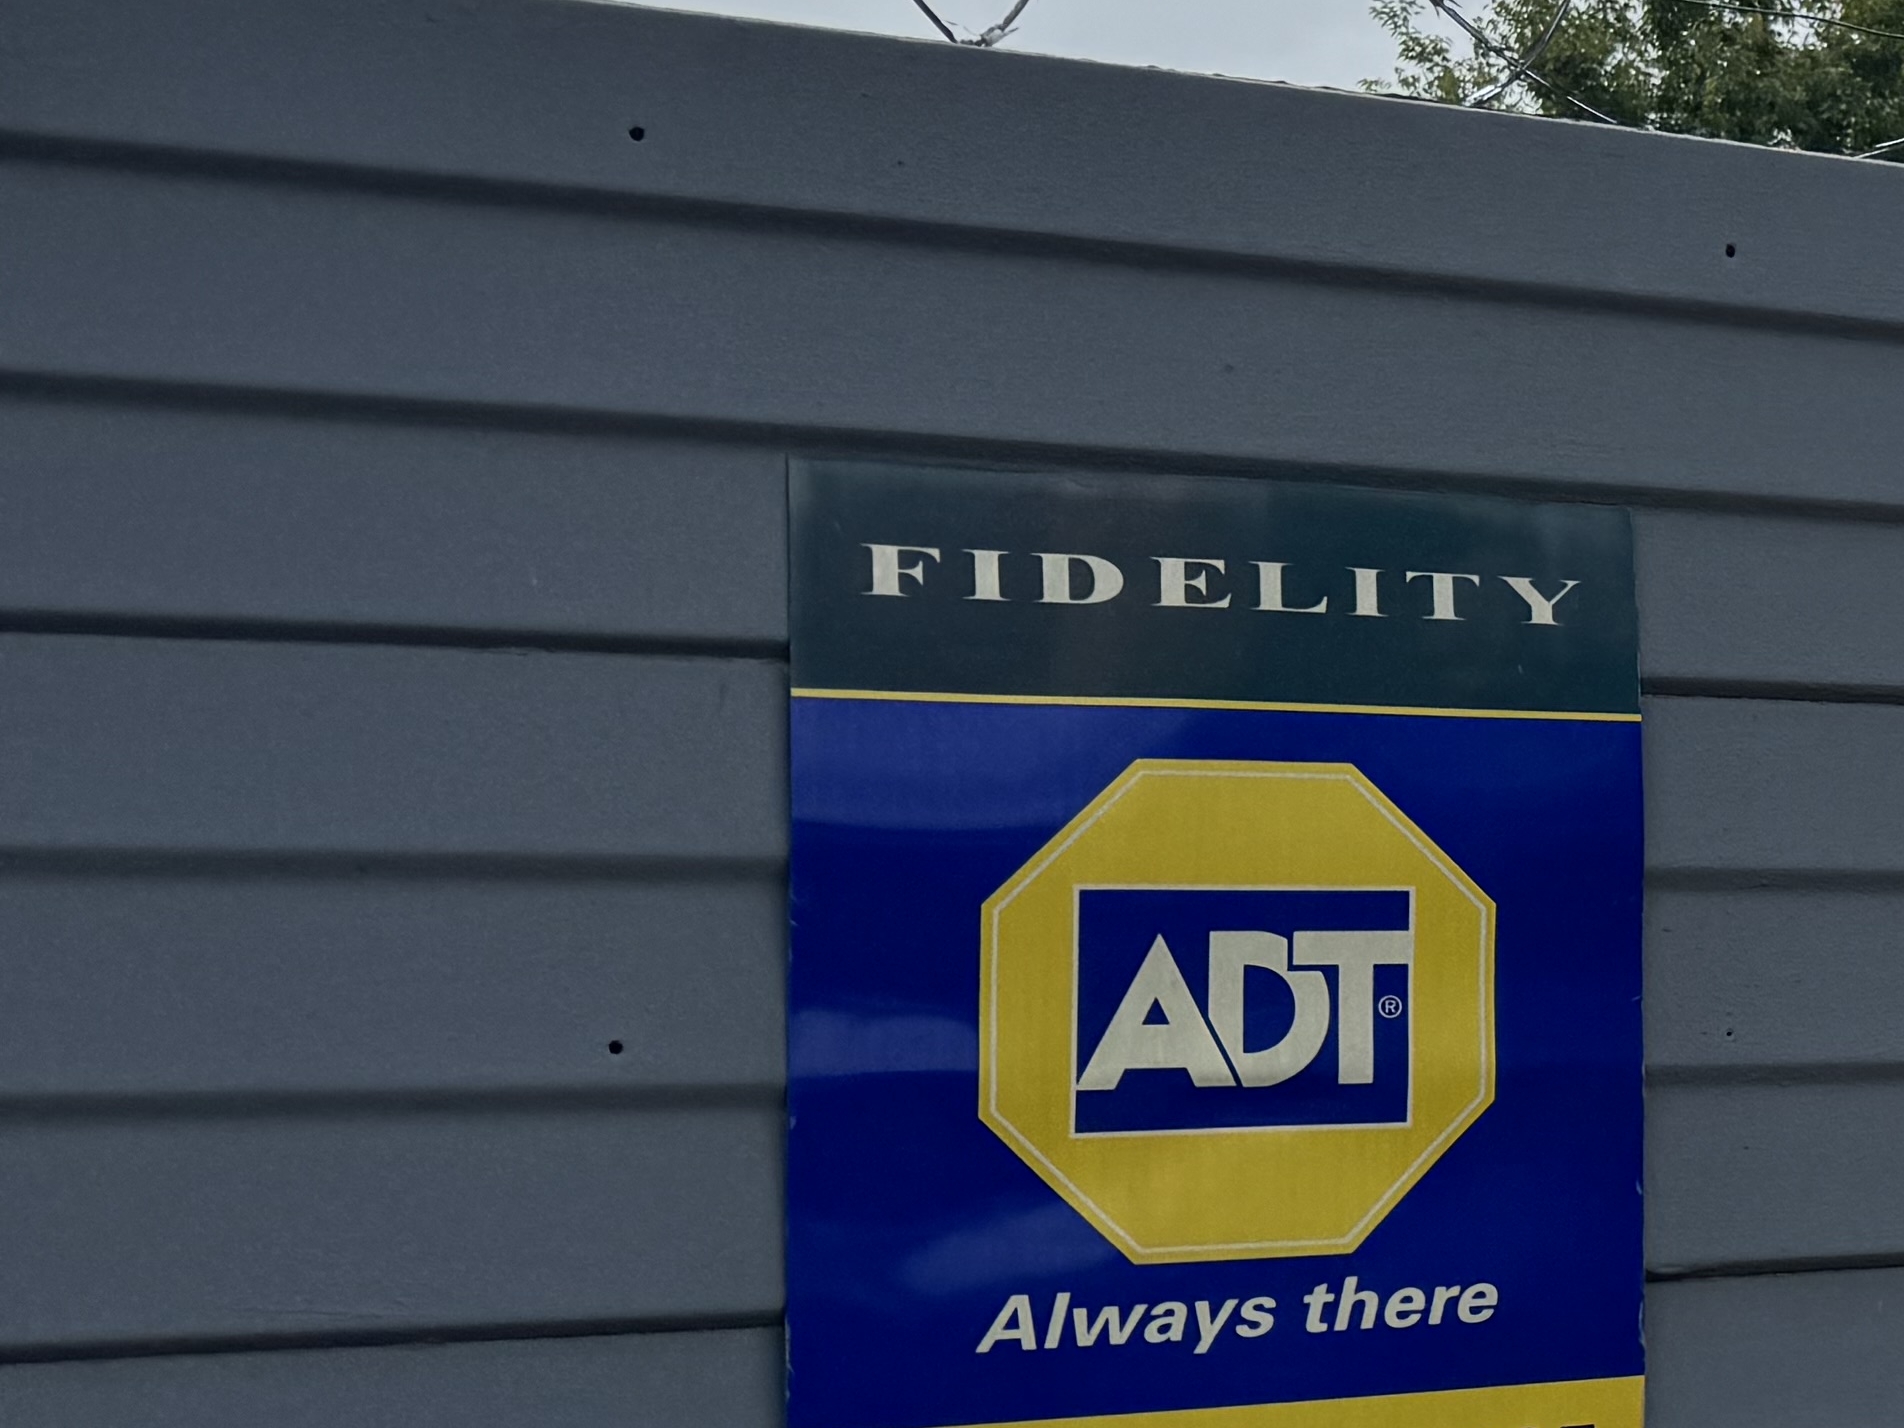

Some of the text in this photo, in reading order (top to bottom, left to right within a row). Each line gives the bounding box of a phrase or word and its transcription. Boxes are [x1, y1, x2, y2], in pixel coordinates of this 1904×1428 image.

[860, 542, 1580, 626] FIDELITY
[976, 1275, 1499, 1354] Always there
